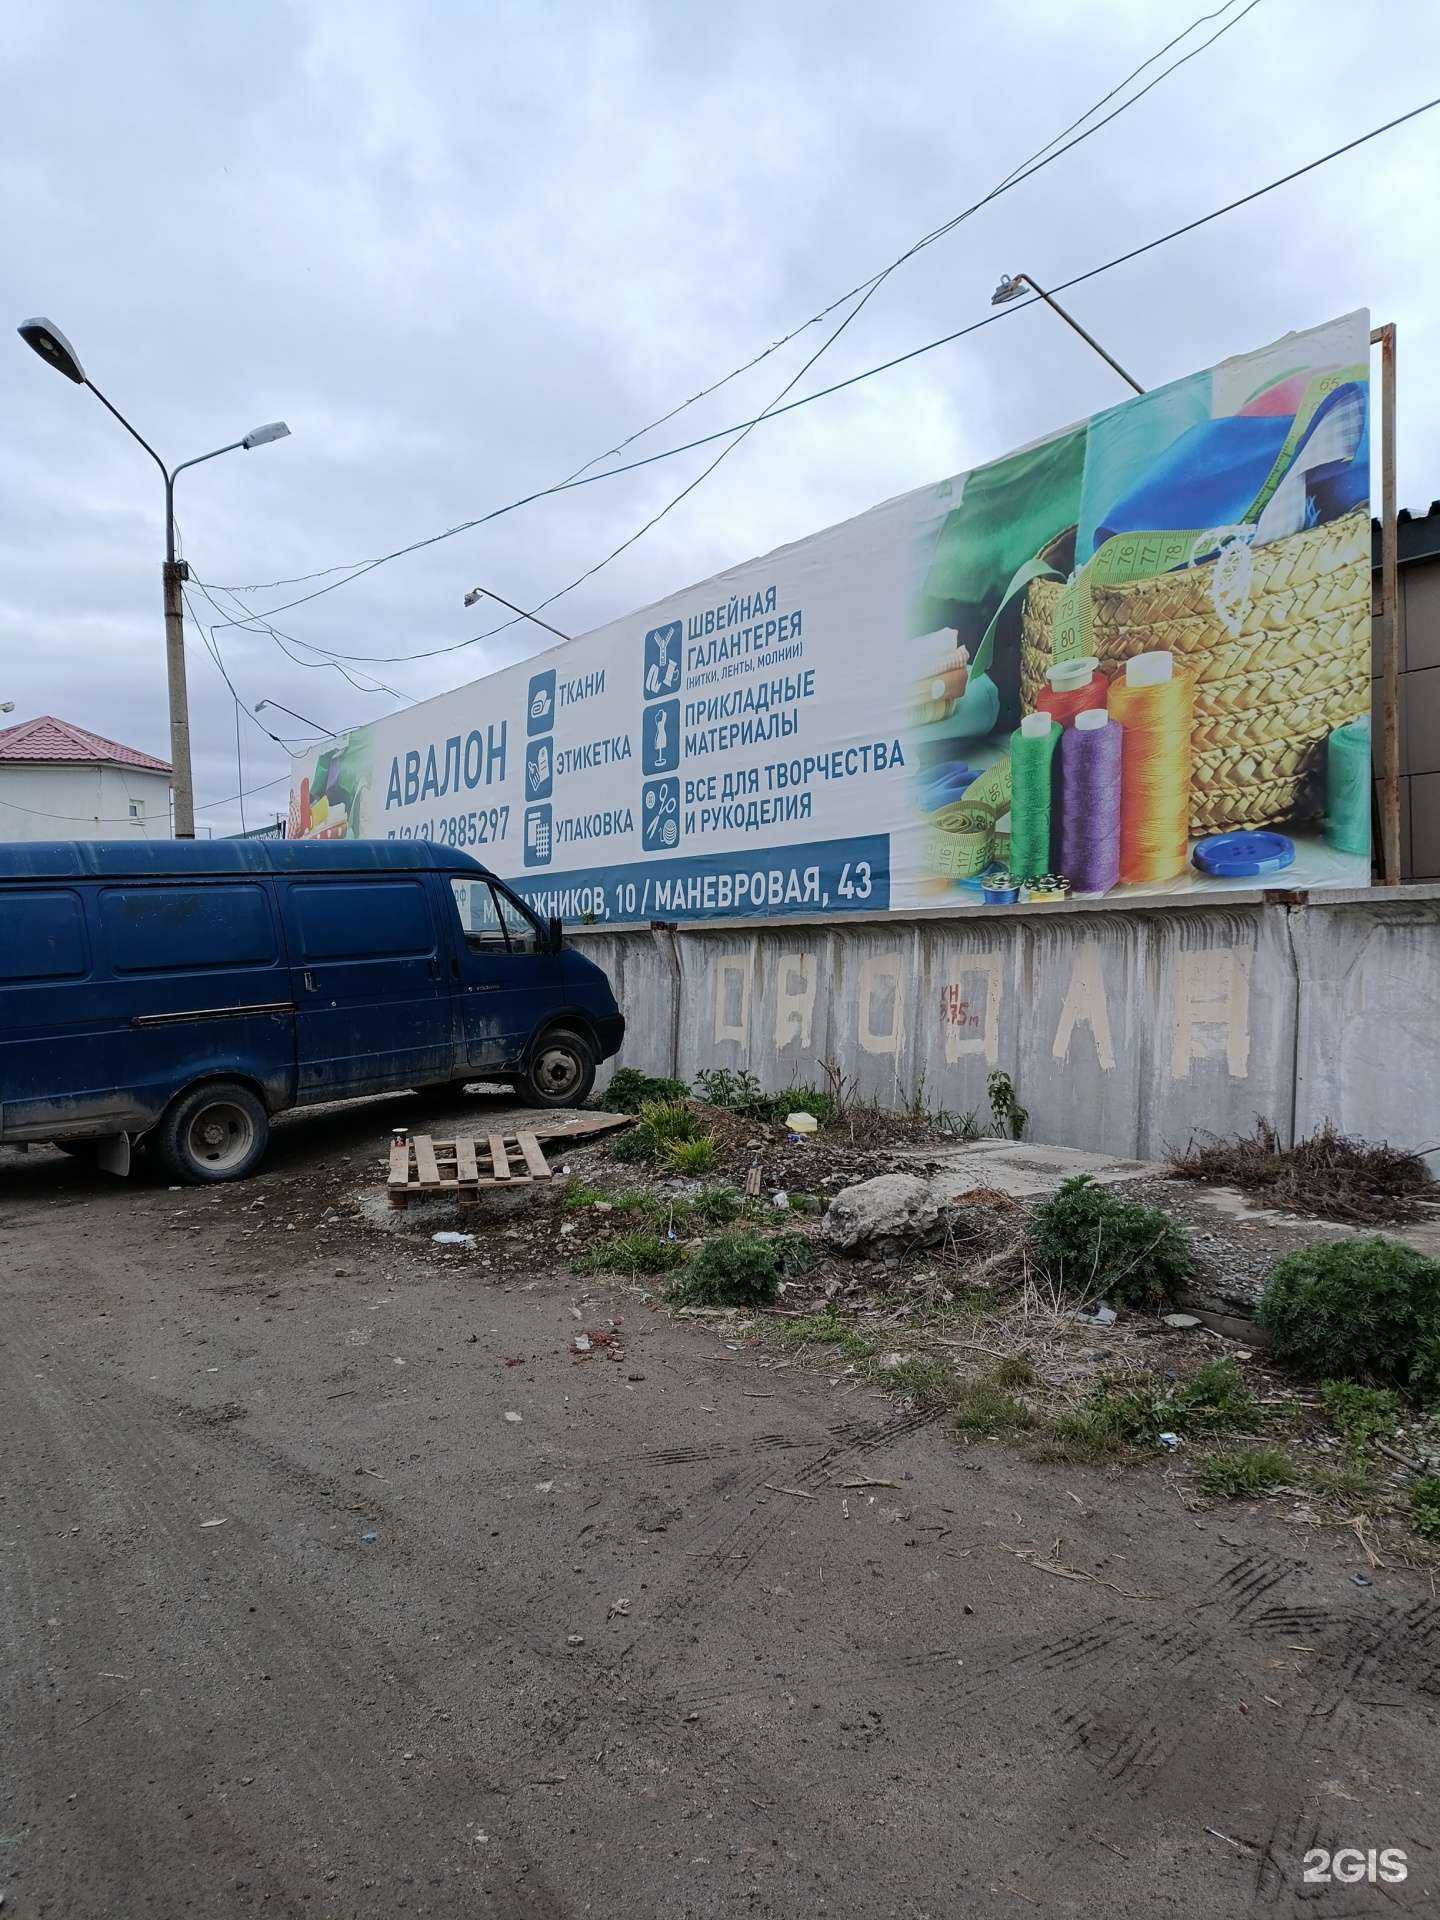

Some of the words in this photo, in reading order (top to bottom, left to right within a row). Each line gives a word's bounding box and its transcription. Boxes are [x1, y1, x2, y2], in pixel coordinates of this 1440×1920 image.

[688, 585, 777, 641] ШВЕЙНАЯ
[687, 610, 802, 671] ГАЛАНТЕРЕЯ
[721, 659, 755, 679] ЛЕНТЫ,
[757, 641, 803, 668] МОЛНИИ)
[1060, 627, 1076, 648] 80
[559, 669, 606, 707] ТКАНИ
[684, 669, 816, 728] ПРИКЛАДНЫЕ
[556, 734, 633, 776] ЭТИКЕТКА
[684, 708, 799, 758] МАТЕРИАЛЫ
[385, 719, 508, 811] АВАЛОН
[685, 776, 717, 804] ВСЕ
[721, 767, 760, 802] ДЛЯ
[764, 738, 905, 791] ТВОРЧЕСТВА
[439, 805, 511, 848] 2885297
[556, 808, 635, 844] УПАКОВКА
[685, 811, 696, 835] И
[701, 791, 812, 832] РУКОДЕЛИЯ
[616, 882, 636, 914] 10
[655, 865, 829, 911] МАНЕВРОВАЯ,
[837, 861, 872, 900] 43
